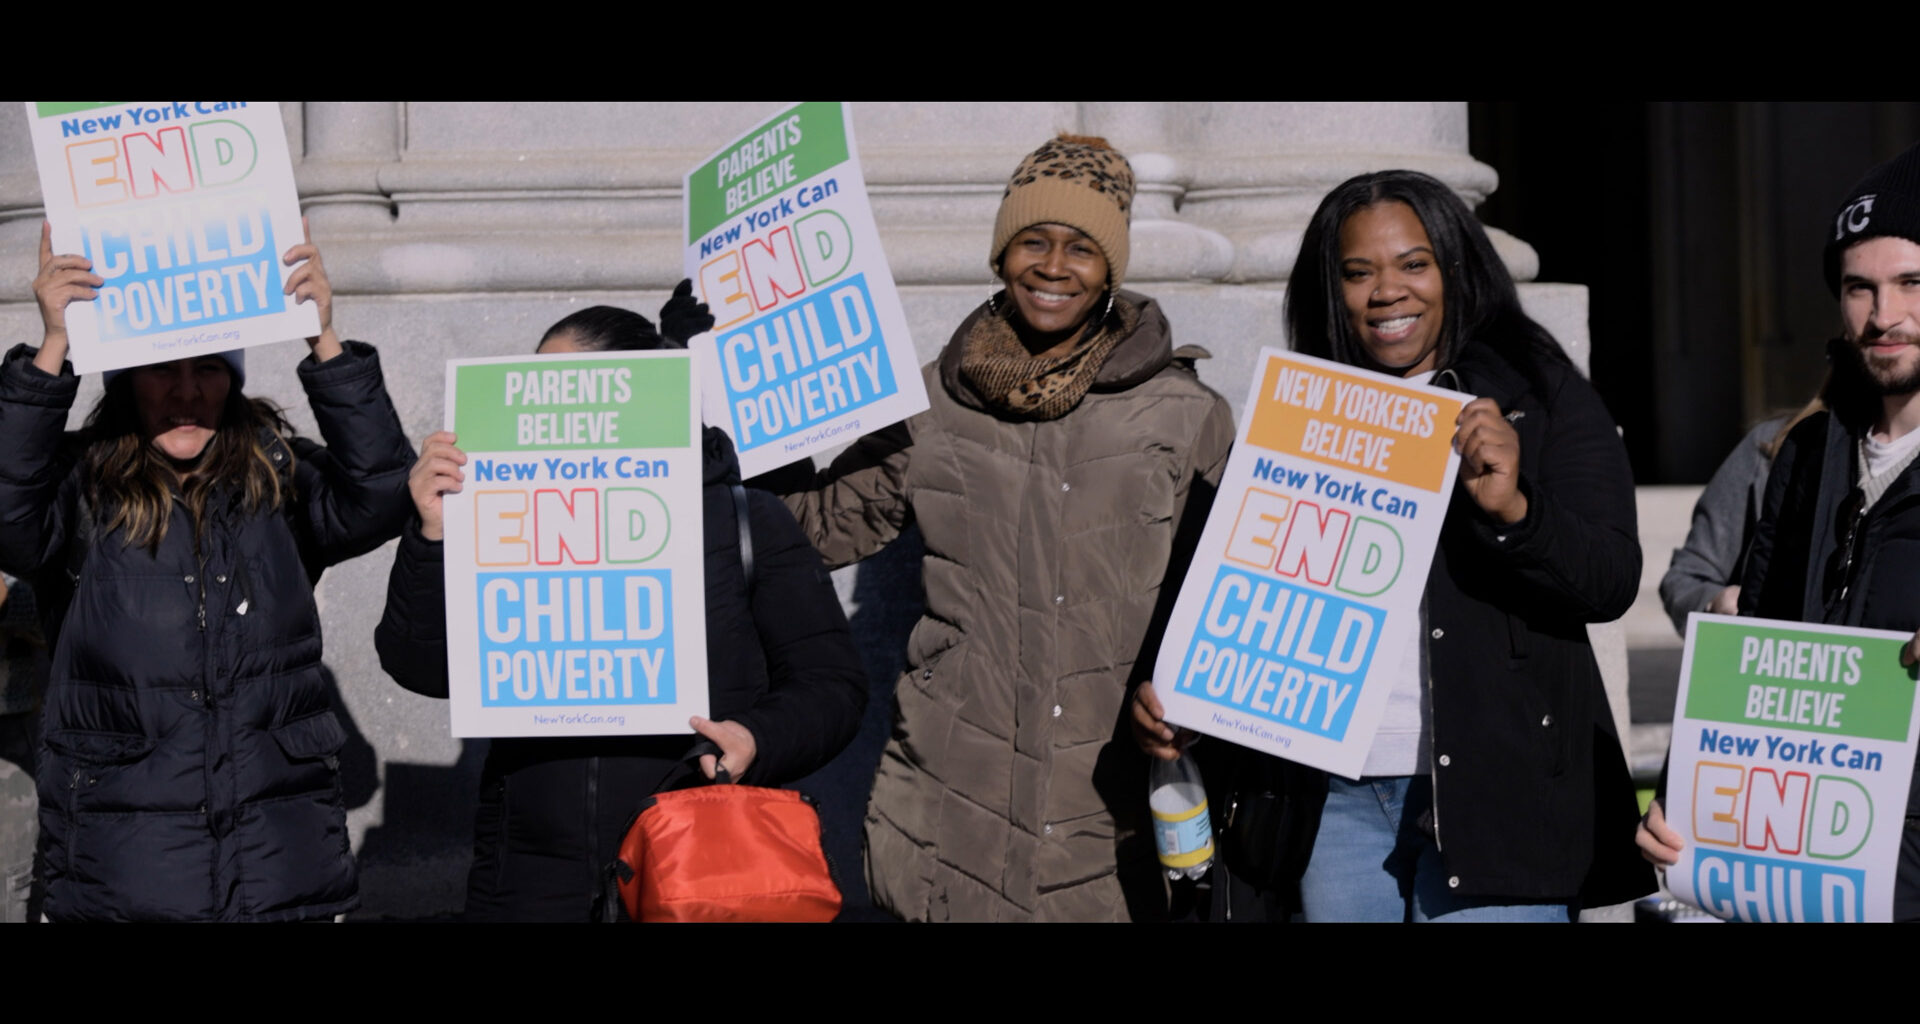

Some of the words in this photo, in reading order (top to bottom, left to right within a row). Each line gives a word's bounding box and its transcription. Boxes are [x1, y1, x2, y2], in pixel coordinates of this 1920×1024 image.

[61, 113, 122, 138] New
[126, 105, 191, 128] York
[718, 114, 802, 188] PARENTS
[65, 119, 258, 208] END
[725, 154, 798, 215] BELIEVE
[87, 198, 266, 280] CHILD
[700, 223, 742, 259] New
[745, 197, 794, 233] York
[797, 178, 839, 209] Can
[104, 260, 270, 332] POVERTY
[700, 209, 853, 331] END
[153, 330, 241, 352] NewYorkCan.org
[723, 285, 873, 394] CHILD
[505, 367, 632, 406] PARENTS
[736, 346, 883, 446] POVERTY
[1273, 367, 1330, 411] NEW
[1334, 380, 1439, 439] YORKERS
[517, 411, 619, 445] BELIEVE
[784, 418, 861, 454] NewYorkCan.org
[1301, 419, 1395, 473] BELIEVE
[475, 459, 538, 482] New
[543, 457, 608, 481] York
[615, 456, 669, 478] Can
[1253, 457, 1309, 489] New
[1312, 471, 1366, 506] York
[1370, 488, 1418, 519] Can
[474, 487, 671, 567] END
[1224, 486, 1404, 597] END
[483, 576, 665, 643] CHILD
[1205, 574, 1374, 675] CHILD
[487, 648, 665, 700] POVERTY
[1184, 640, 1352, 731] POVERTY
[1740, 636, 1863, 686] PARENTS
[534, 712, 625, 726] NewYorkCan.org
[1211, 711, 1292, 747] NewYorkCan.org
[1744, 684, 1845, 728] BELIEVE
[1700, 728, 1759, 757] New
[1765, 735, 1825, 765] York
[1830, 743, 1882, 772] Can
[1692, 761, 1874, 860] END
